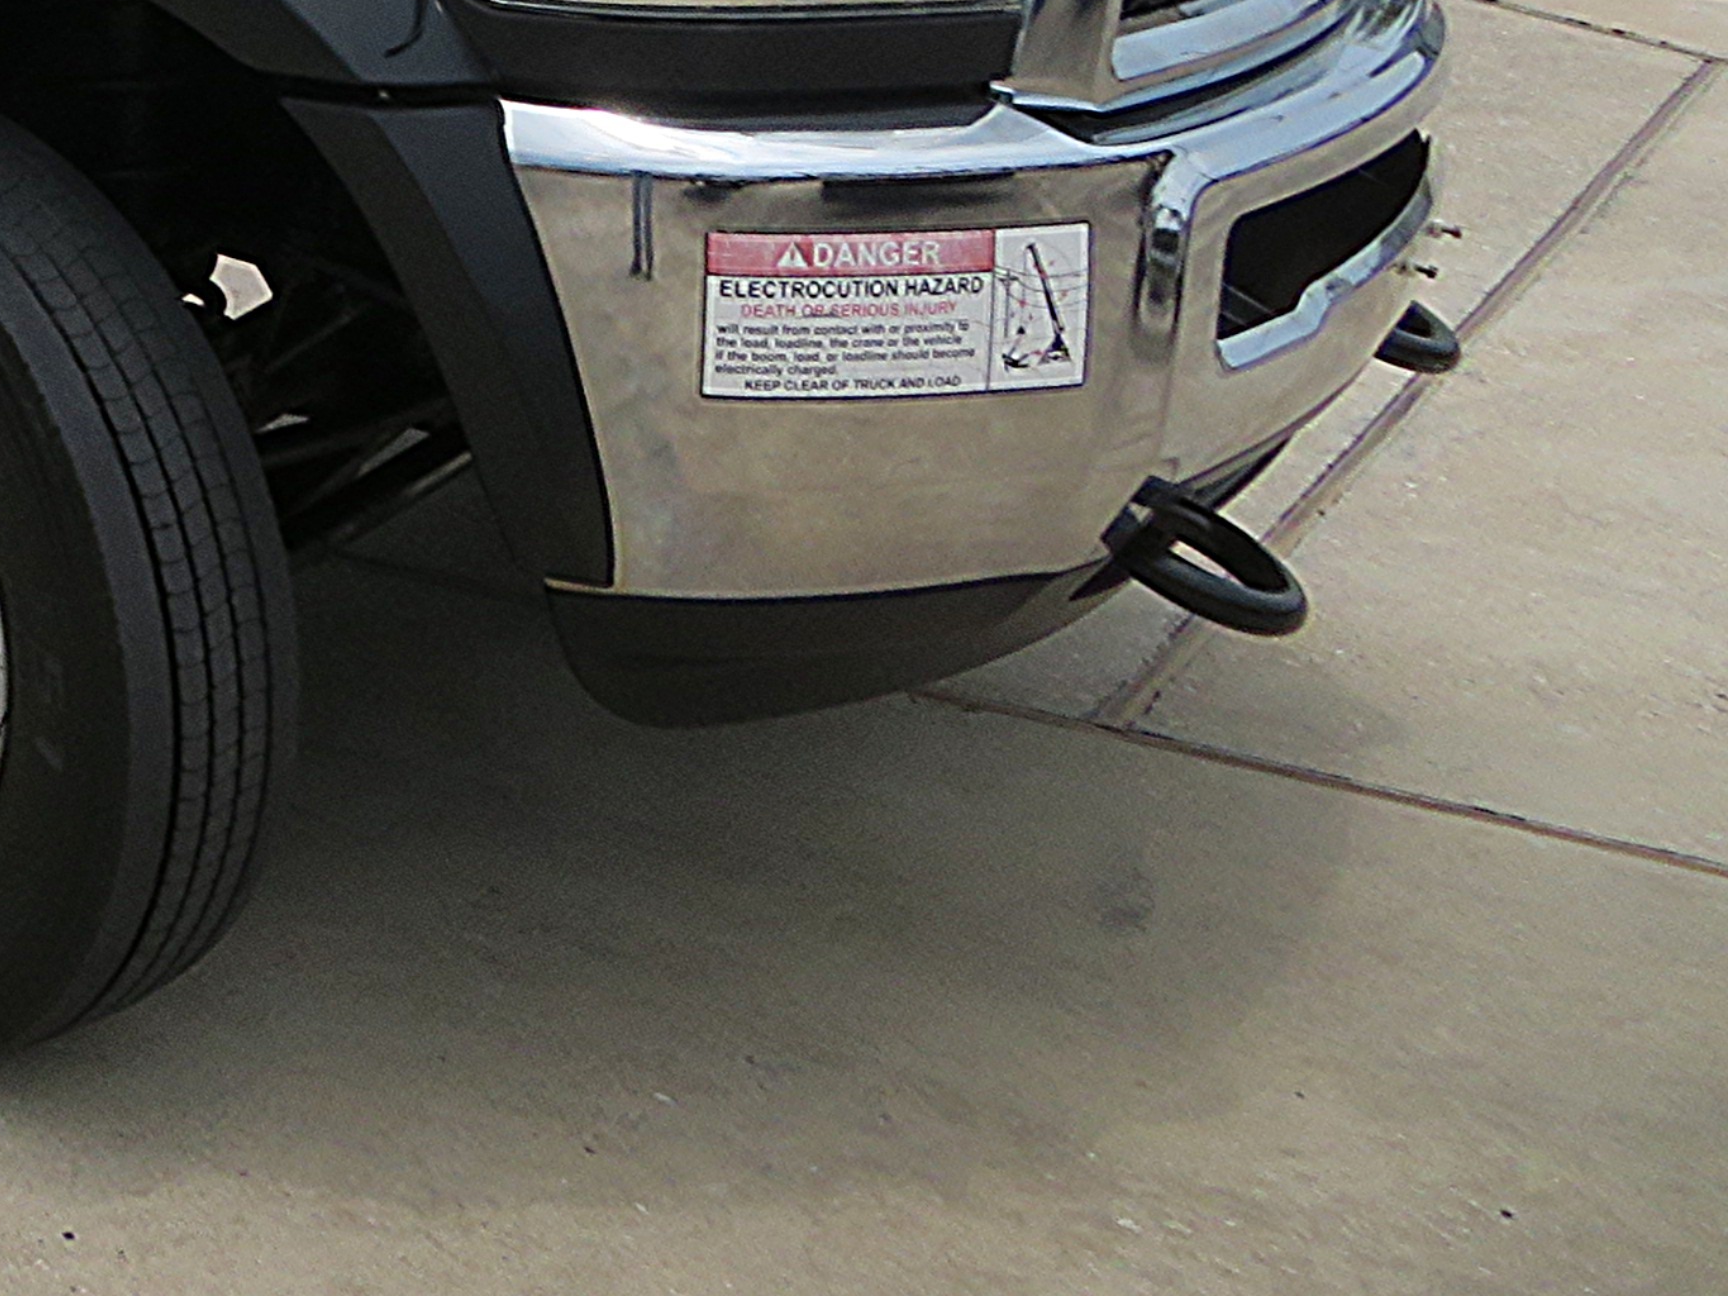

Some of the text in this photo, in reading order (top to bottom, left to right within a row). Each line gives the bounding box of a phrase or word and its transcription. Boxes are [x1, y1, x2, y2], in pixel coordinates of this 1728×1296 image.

[812, 240, 941, 268] DANGER
[719, 275, 984, 299] ELECTROCUTION HAZARD
[740, 300, 957, 318] DEATH OR SERIOUS INJURY
[716, 323, 739, 335] will
[744, 324, 779, 336] result
[782, 324, 810, 336] from
[814, 324, 857, 336] contact
[861, 323, 886, 335] with
[889, 325, 900, 335] or
[904, 321, 955, 336] proximity
[716, 337, 738, 348] the
[829, 337, 849, 348] the
[851, 338, 885, 348] crane
[887, 338, 899, 348] or
[902, 336, 921, 347] the
[923, 334, 963, 346] vehicle
[727, 351, 748, 362] the
[826, 353, 838, 363] or
[890, 349, 930, 360] should
[932, 348, 976, 359] become
[714, 364, 783, 377] electrically
[745, 374, 962, 391] KEEP CLEAR OF TRUCK AND LOAD
